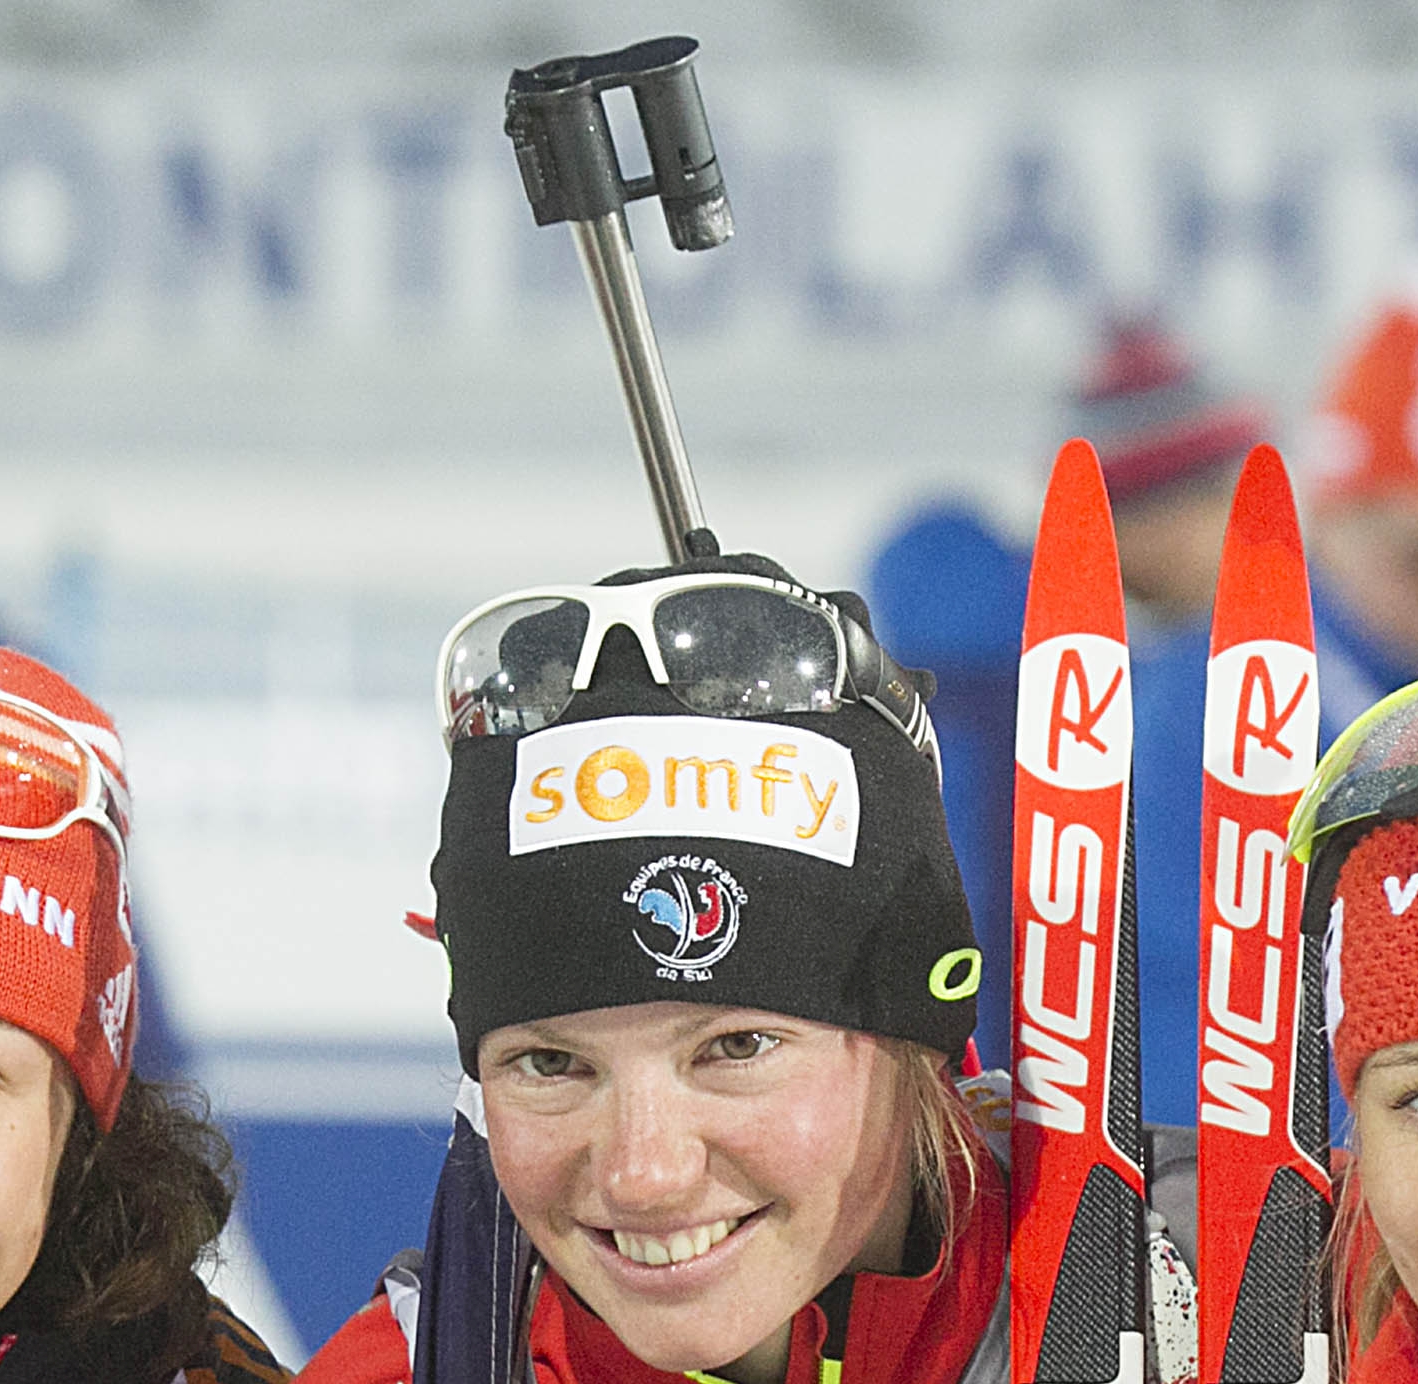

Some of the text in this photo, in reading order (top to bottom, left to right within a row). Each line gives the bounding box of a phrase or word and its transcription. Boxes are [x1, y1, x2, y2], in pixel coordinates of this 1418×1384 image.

[524, 742, 839, 839] somfy
[1015, 810, 1104, 1135] WCS
[1201, 815, 1288, 1136] WCS
